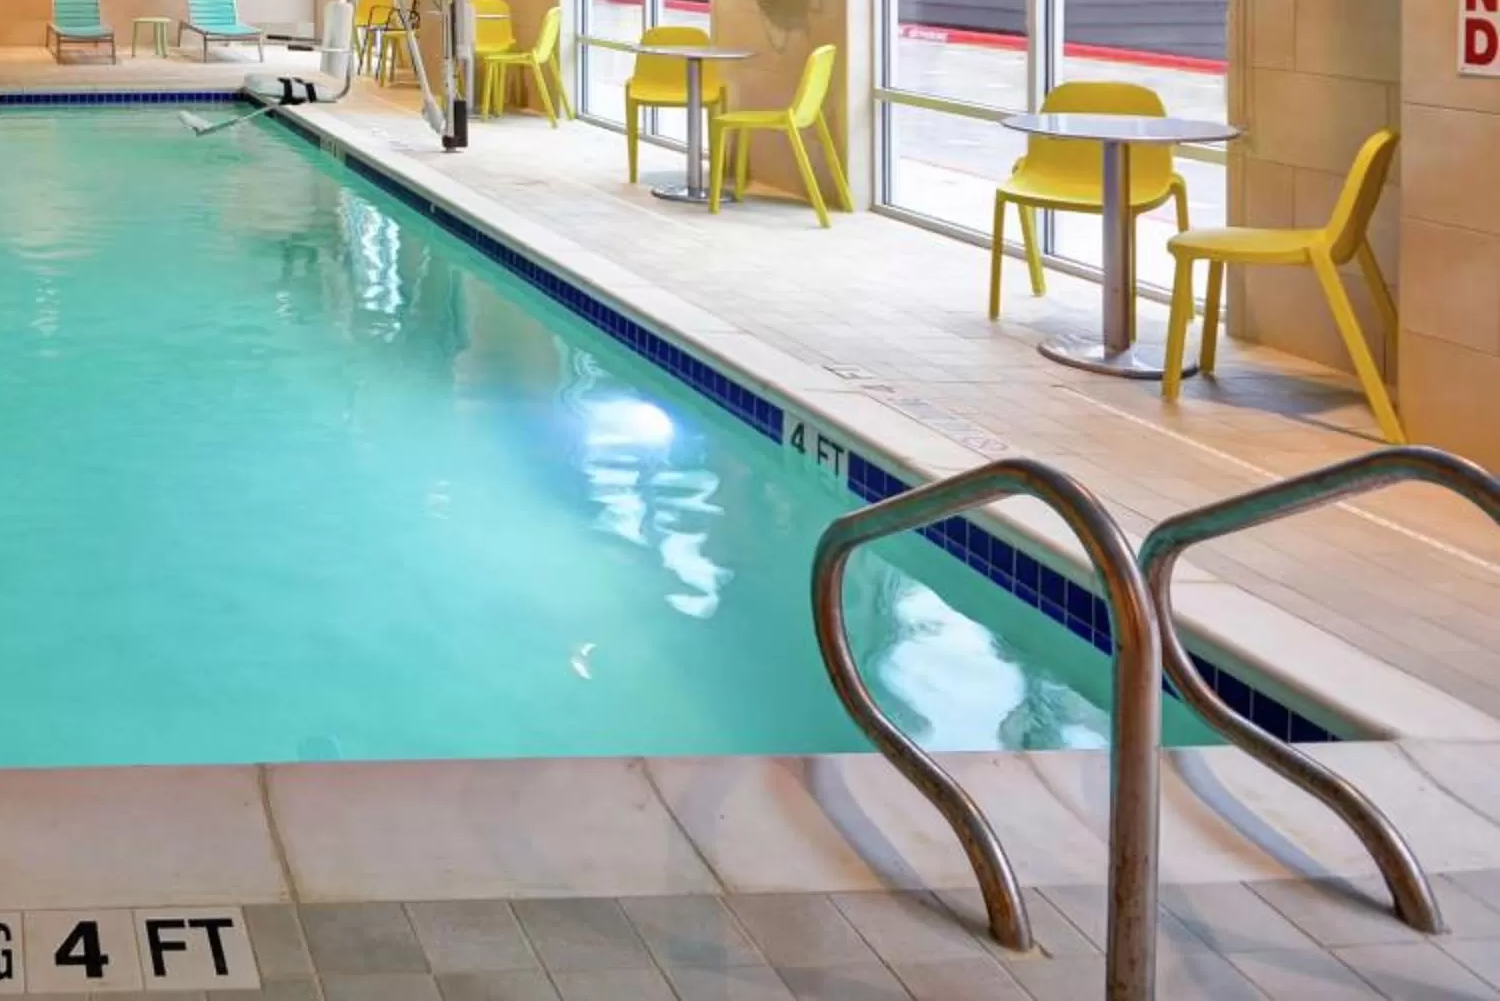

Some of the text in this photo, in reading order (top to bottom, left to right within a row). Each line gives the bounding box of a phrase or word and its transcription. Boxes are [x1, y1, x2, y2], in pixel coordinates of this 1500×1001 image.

[791, 423, 845, 476] 4 FT
[54, 920, 109, 978] 4
[146, 917, 233, 976] FT
